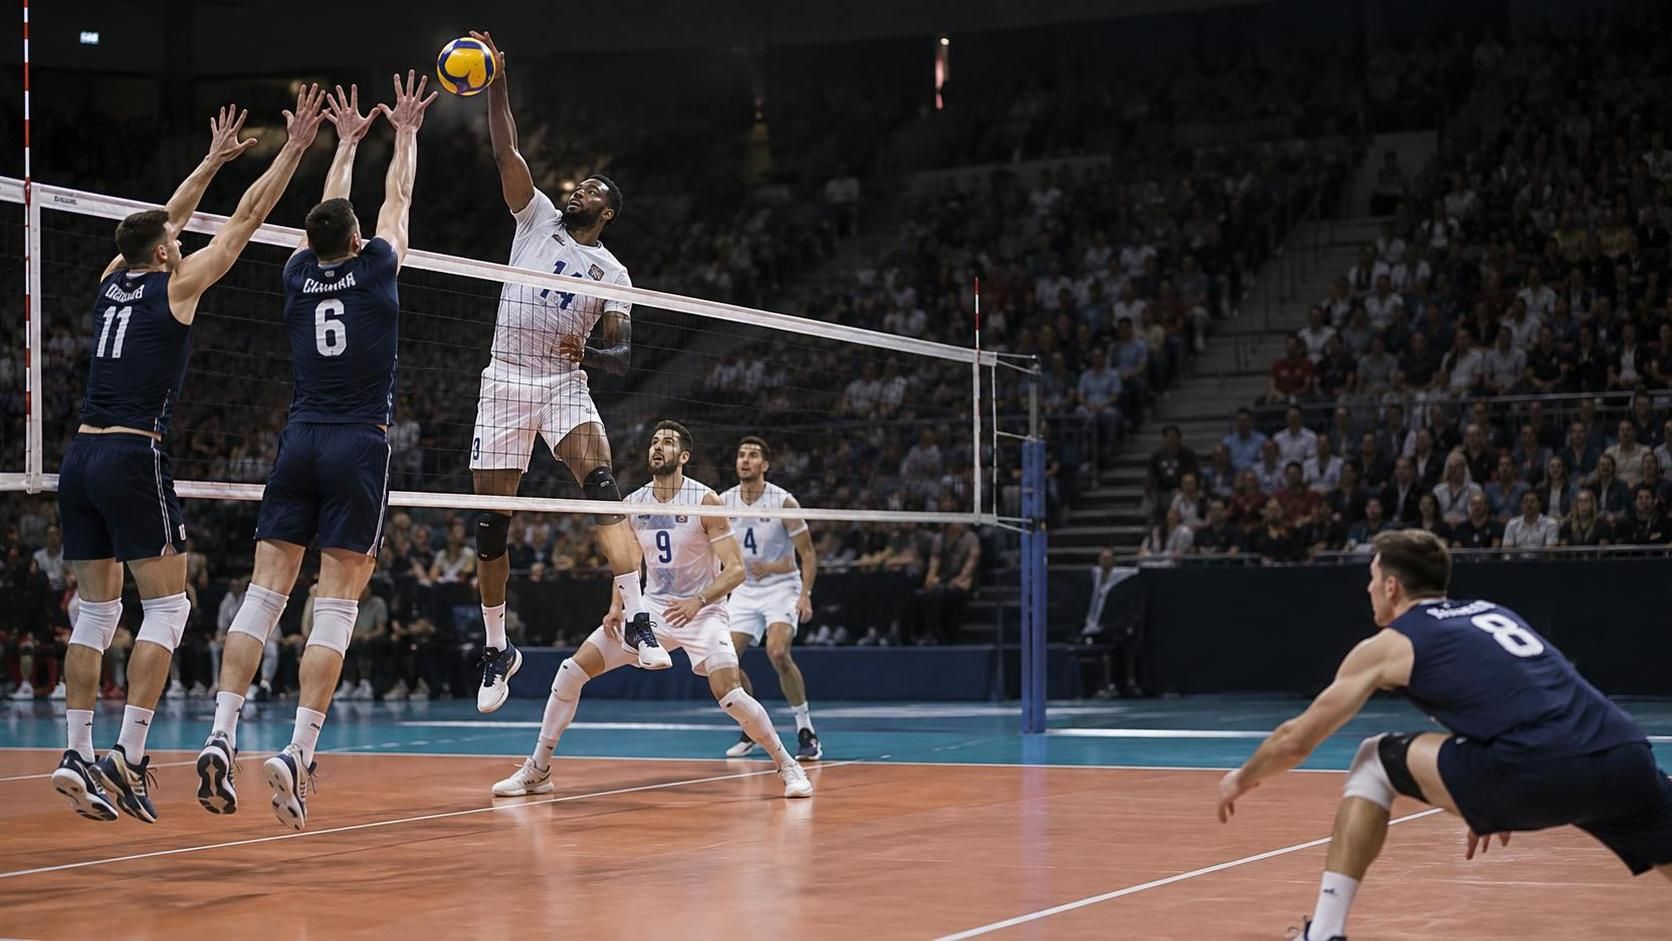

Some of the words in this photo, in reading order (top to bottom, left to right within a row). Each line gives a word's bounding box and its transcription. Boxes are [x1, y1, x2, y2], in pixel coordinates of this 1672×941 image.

[96, 306, 133, 359] 11
[315, 298, 347, 357] 6
[655, 530, 672, 563] 9
[744, 527, 757, 555] 4
[1470, 613, 1545, 658] 8
